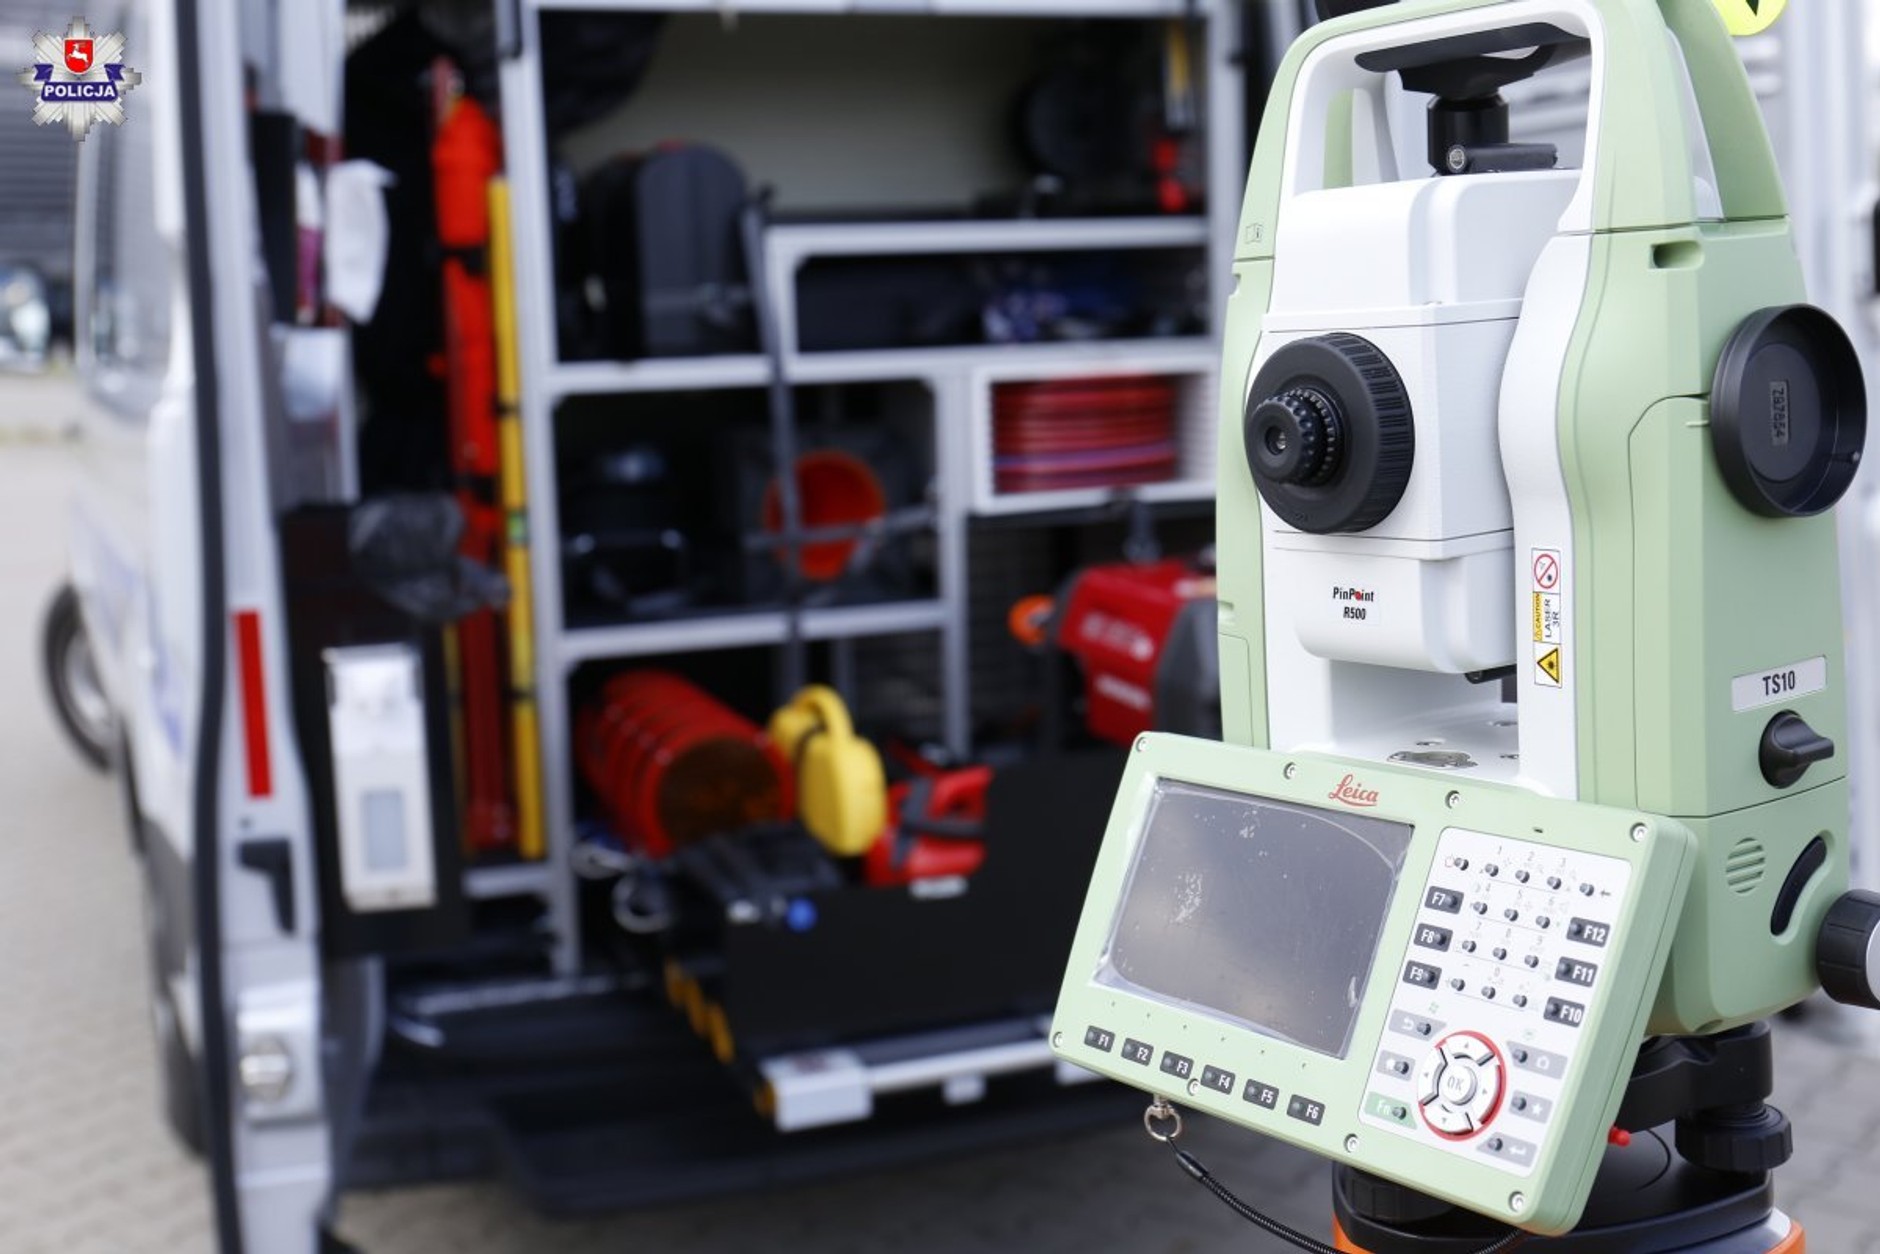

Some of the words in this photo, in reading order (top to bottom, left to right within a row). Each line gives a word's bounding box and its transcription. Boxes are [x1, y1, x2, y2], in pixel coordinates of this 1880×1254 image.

[1332, 586, 1374, 602] PinPoint
[1343, 606, 1366, 620] R500
[1544, 598, 1552, 638] LASER
[1552, 611, 1560, 627] 3R
[1762, 670, 1796, 696] TS10
[1327, 774, 1379, 807] Leica
[1431, 892, 1446, 906] F7
[1420, 929, 1435, 944] F8
[1583, 924, 1606, 943] F12
[1409, 965, 1424, 981] F9
[1571, 964, 1595, 983] F11
[1560, 1004, 1582, 1023] F10
[1097, 1034, 1110, 1048] F1
[1136, 1046, 1150, 1061] F2
[1176, 1060, 1189, 1075] F3
[1217, 1073, 1232, 1089] F4
[1260, 1089, 1275, 1104] F5
[1305, 1103, 1320, 1119] F6
[1447, 1075, 1465, 1092] OK
[1376, 1099, 1391, 1116] Fn
